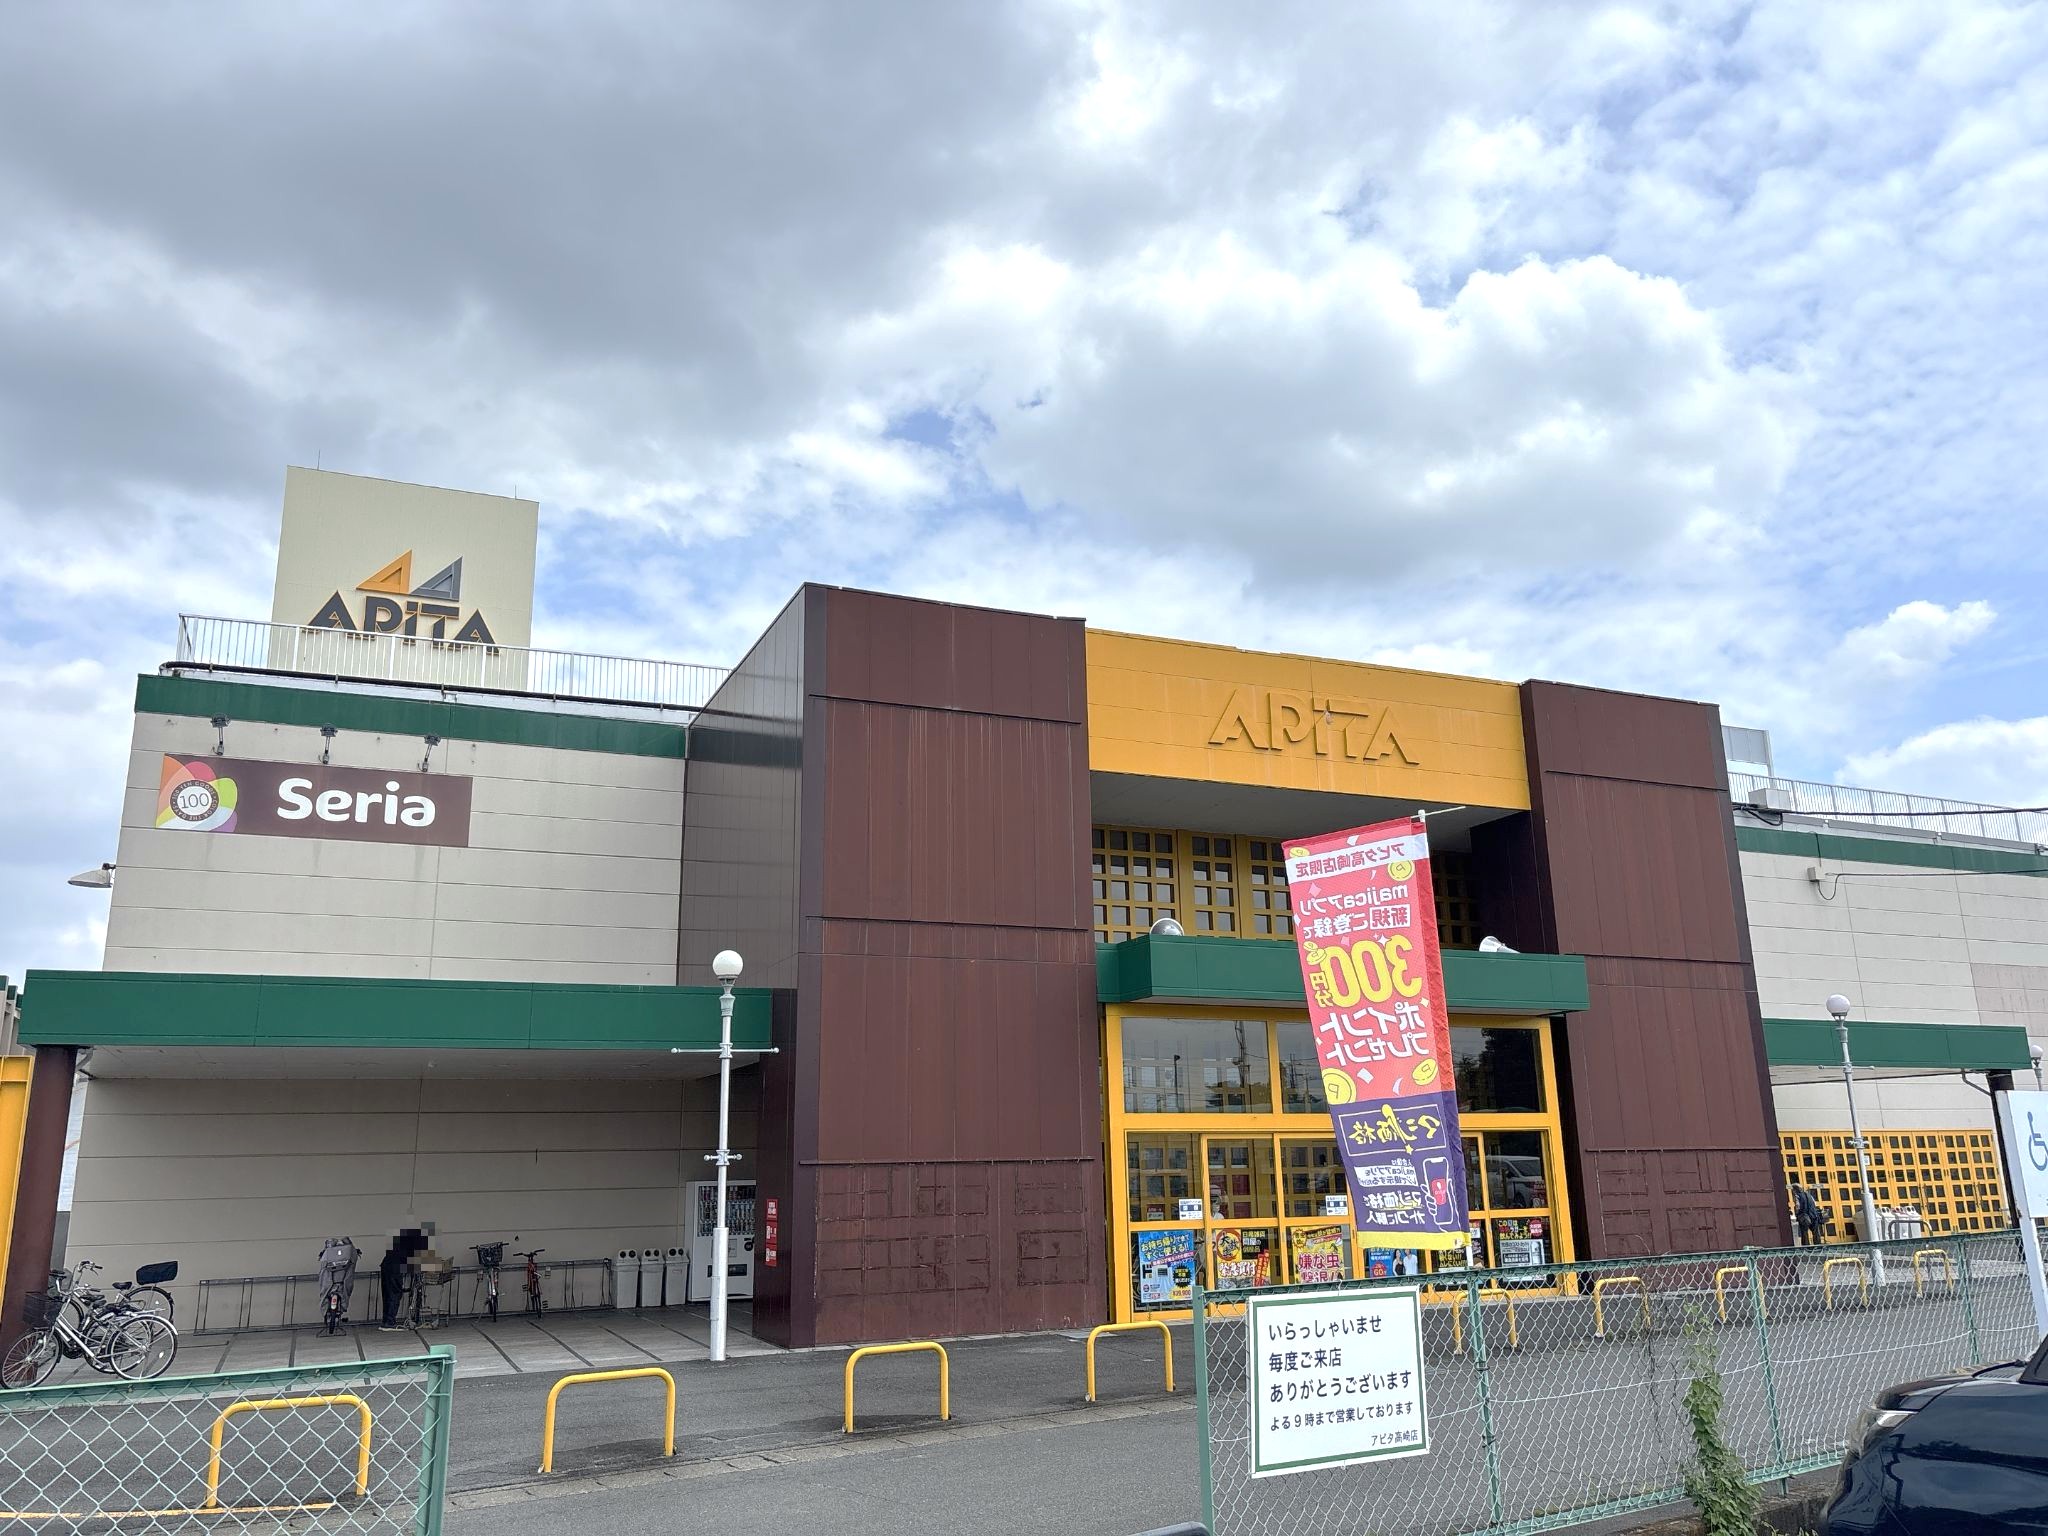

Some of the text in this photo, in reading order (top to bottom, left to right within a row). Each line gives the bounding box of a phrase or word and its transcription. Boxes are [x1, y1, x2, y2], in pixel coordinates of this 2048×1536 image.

[179, 792, 210, 809] 100
[276, 777, 436, 828] Seria
[1298, 1252, 1341, 1271] 嫌な虫
[1268, 1314, 1382, 1342] いらっしゃいませ
[1268, 1347, 1342, 1373] 毎度ご来店
[1270, 1369, 1412, 1404] ありがとうございます
